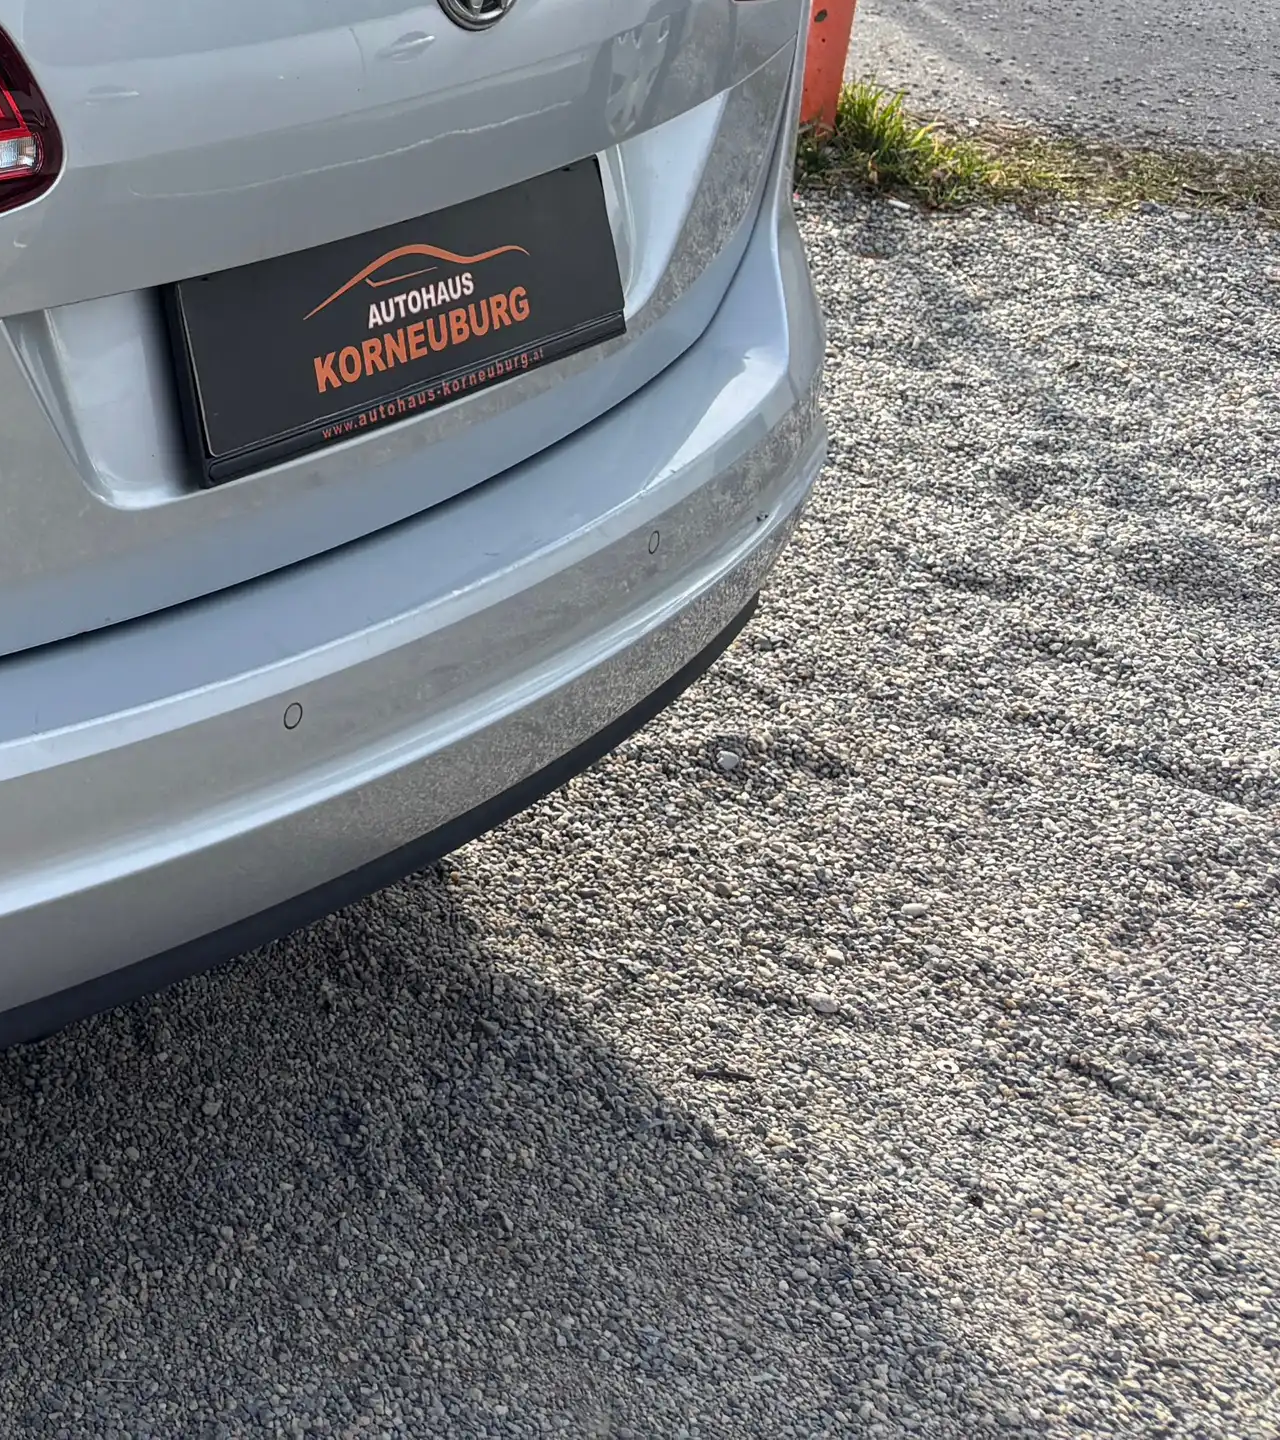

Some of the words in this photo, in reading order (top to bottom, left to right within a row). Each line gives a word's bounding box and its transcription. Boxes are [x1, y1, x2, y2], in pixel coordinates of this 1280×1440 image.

[313, 285, 531, 393] KORNEUBURG
[367, 271, 475, 329] AUTOHAUS
[321, 347, 545, 440] www.autohaus-korneuburg.at
